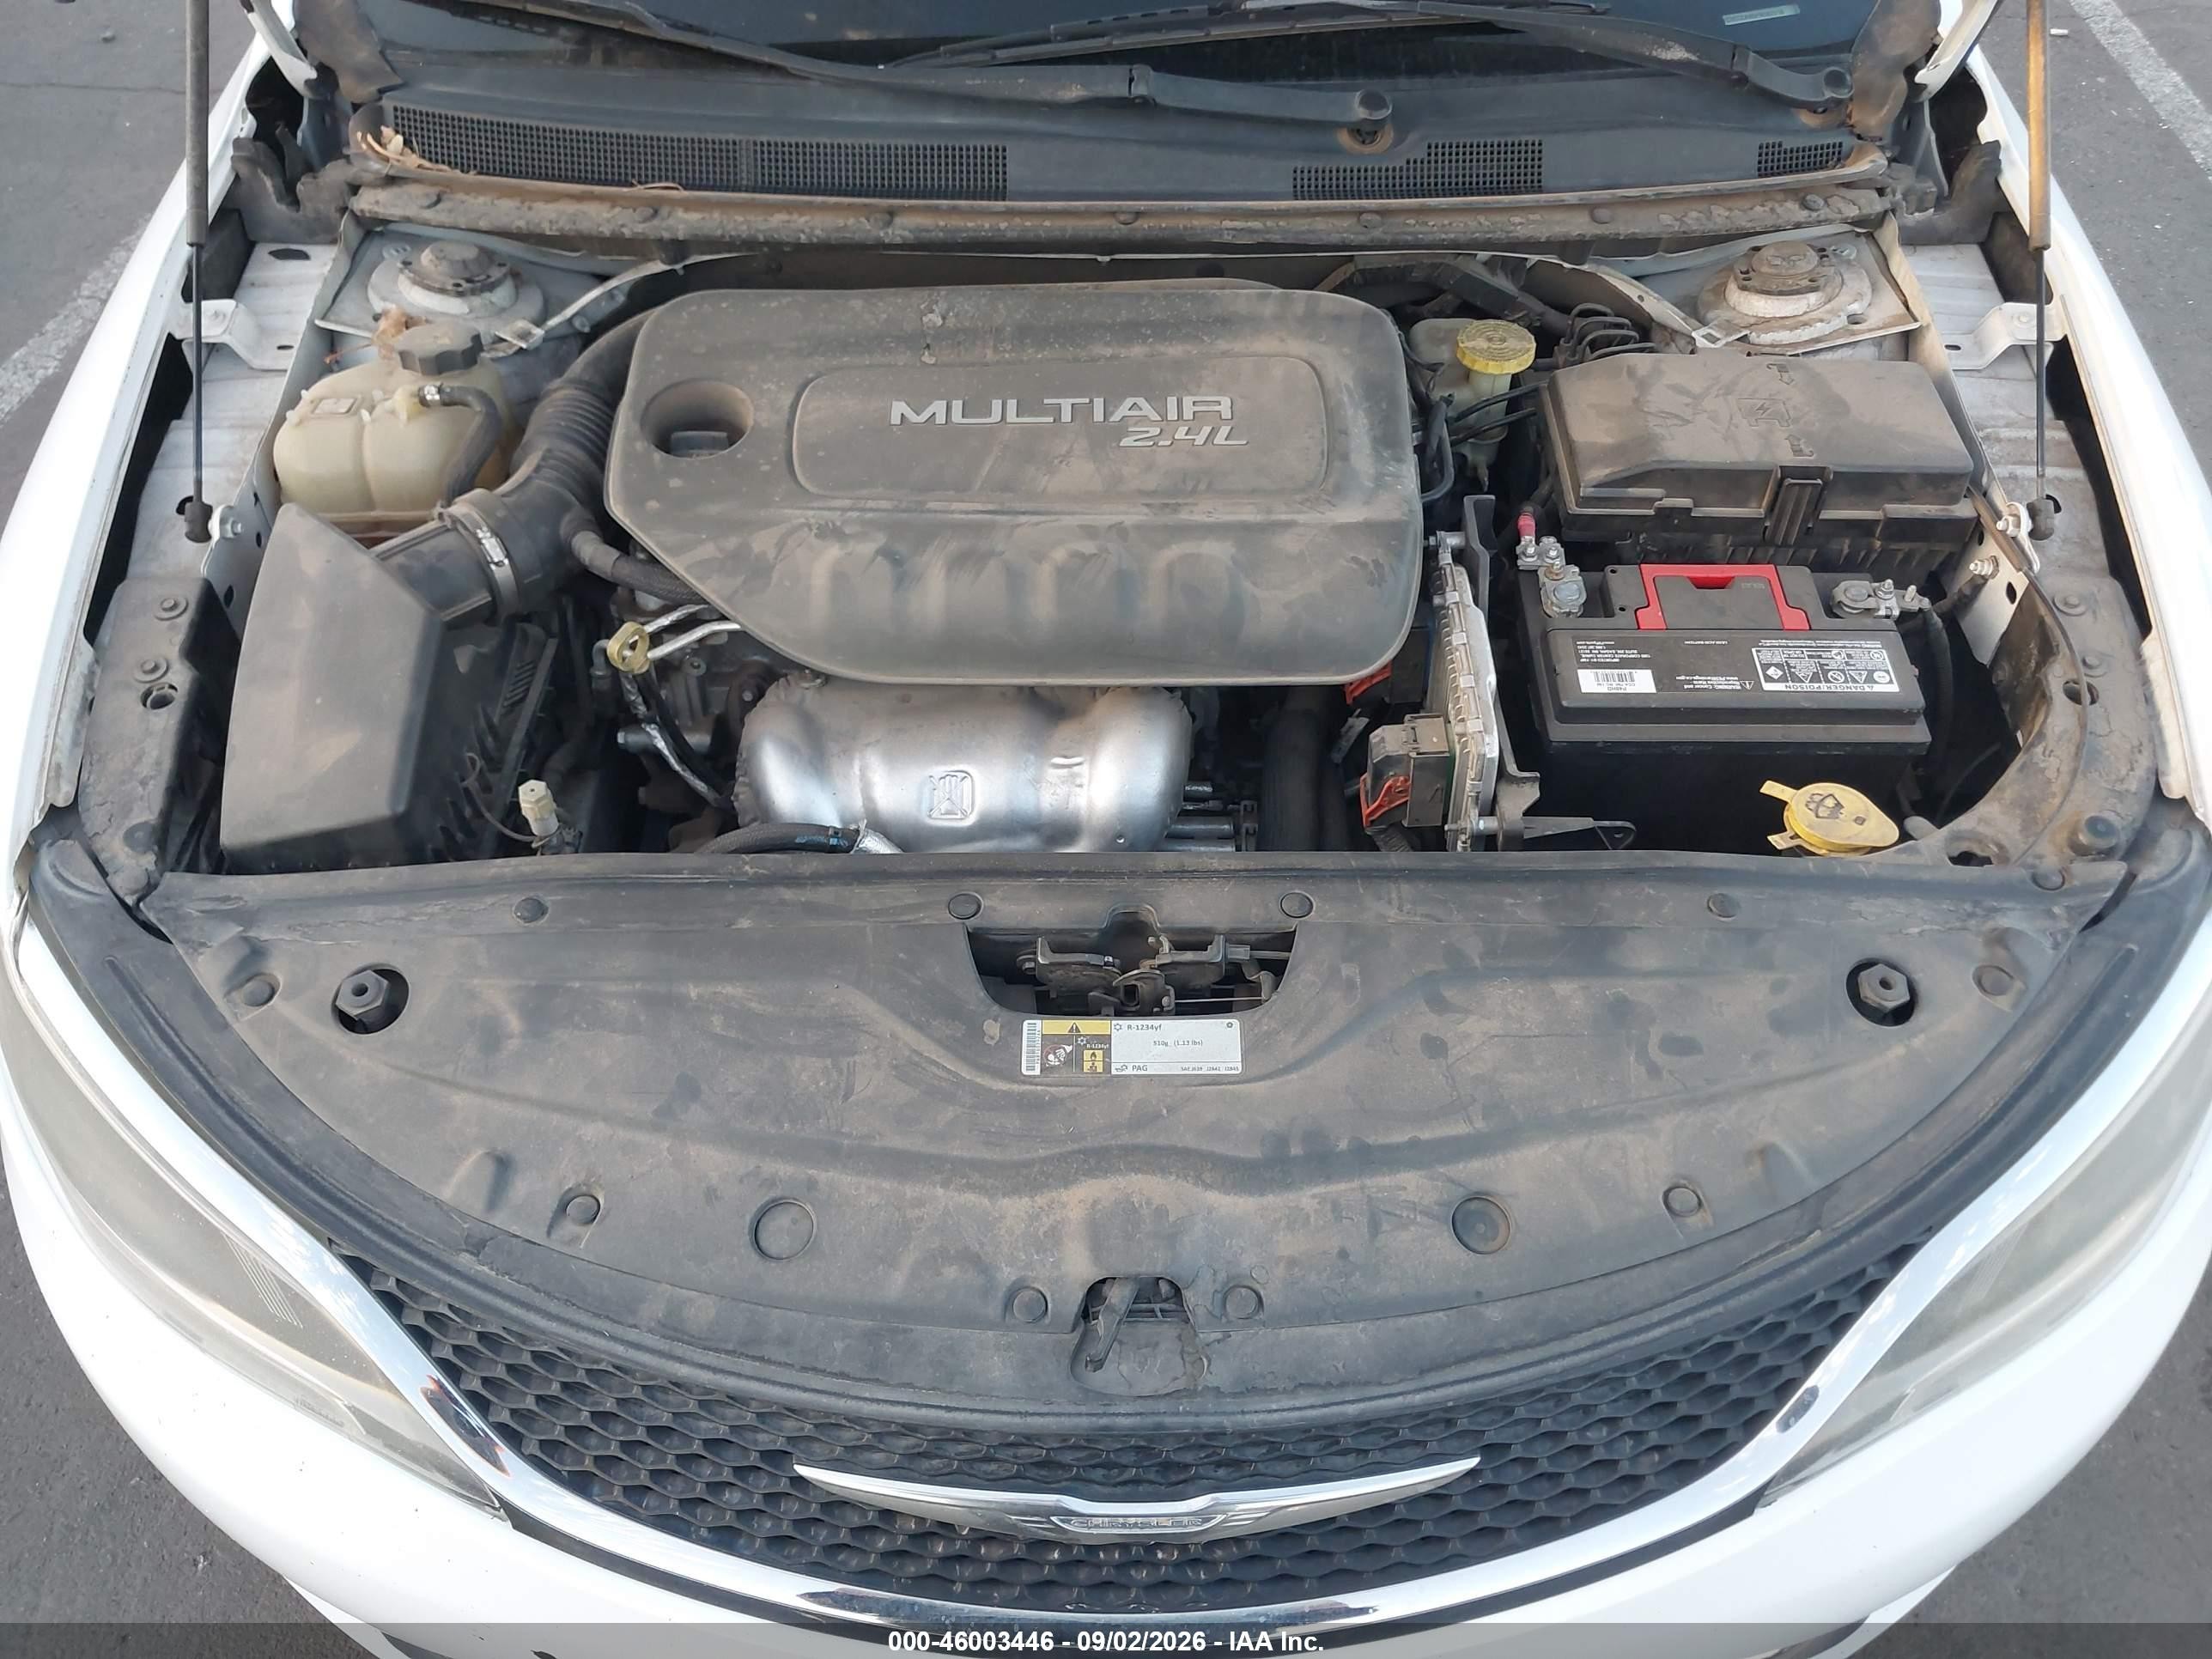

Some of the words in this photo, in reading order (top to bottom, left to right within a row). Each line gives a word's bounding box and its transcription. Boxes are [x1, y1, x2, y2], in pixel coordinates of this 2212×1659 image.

[890, 396, 1233, 425] MULTIAIR
[1119, 425, 1249, 447] 2.4L
[1127, 1024, 1163, 1032] R-1234yf
